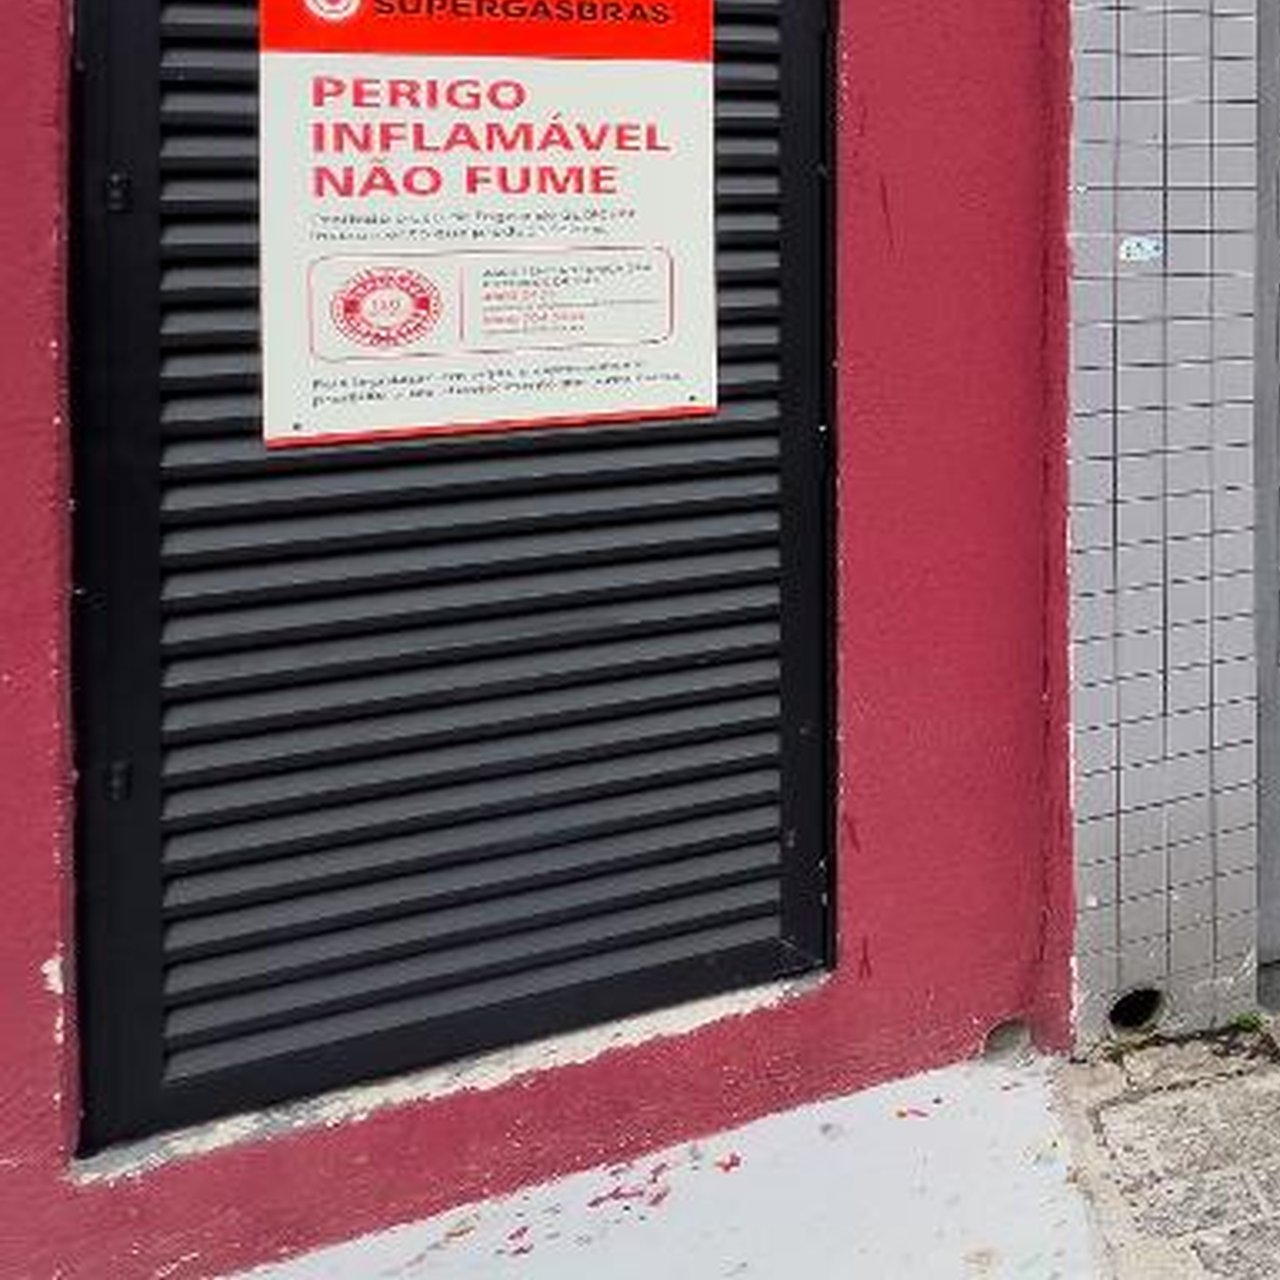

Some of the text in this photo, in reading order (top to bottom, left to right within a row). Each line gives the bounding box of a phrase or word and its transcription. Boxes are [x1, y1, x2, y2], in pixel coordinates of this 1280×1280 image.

[311, 76, 527, 110] PERIGO
[311, 113, 672, 153] INFLAMÁVEL
[312, 156, 619, 197] NÃO FUME
